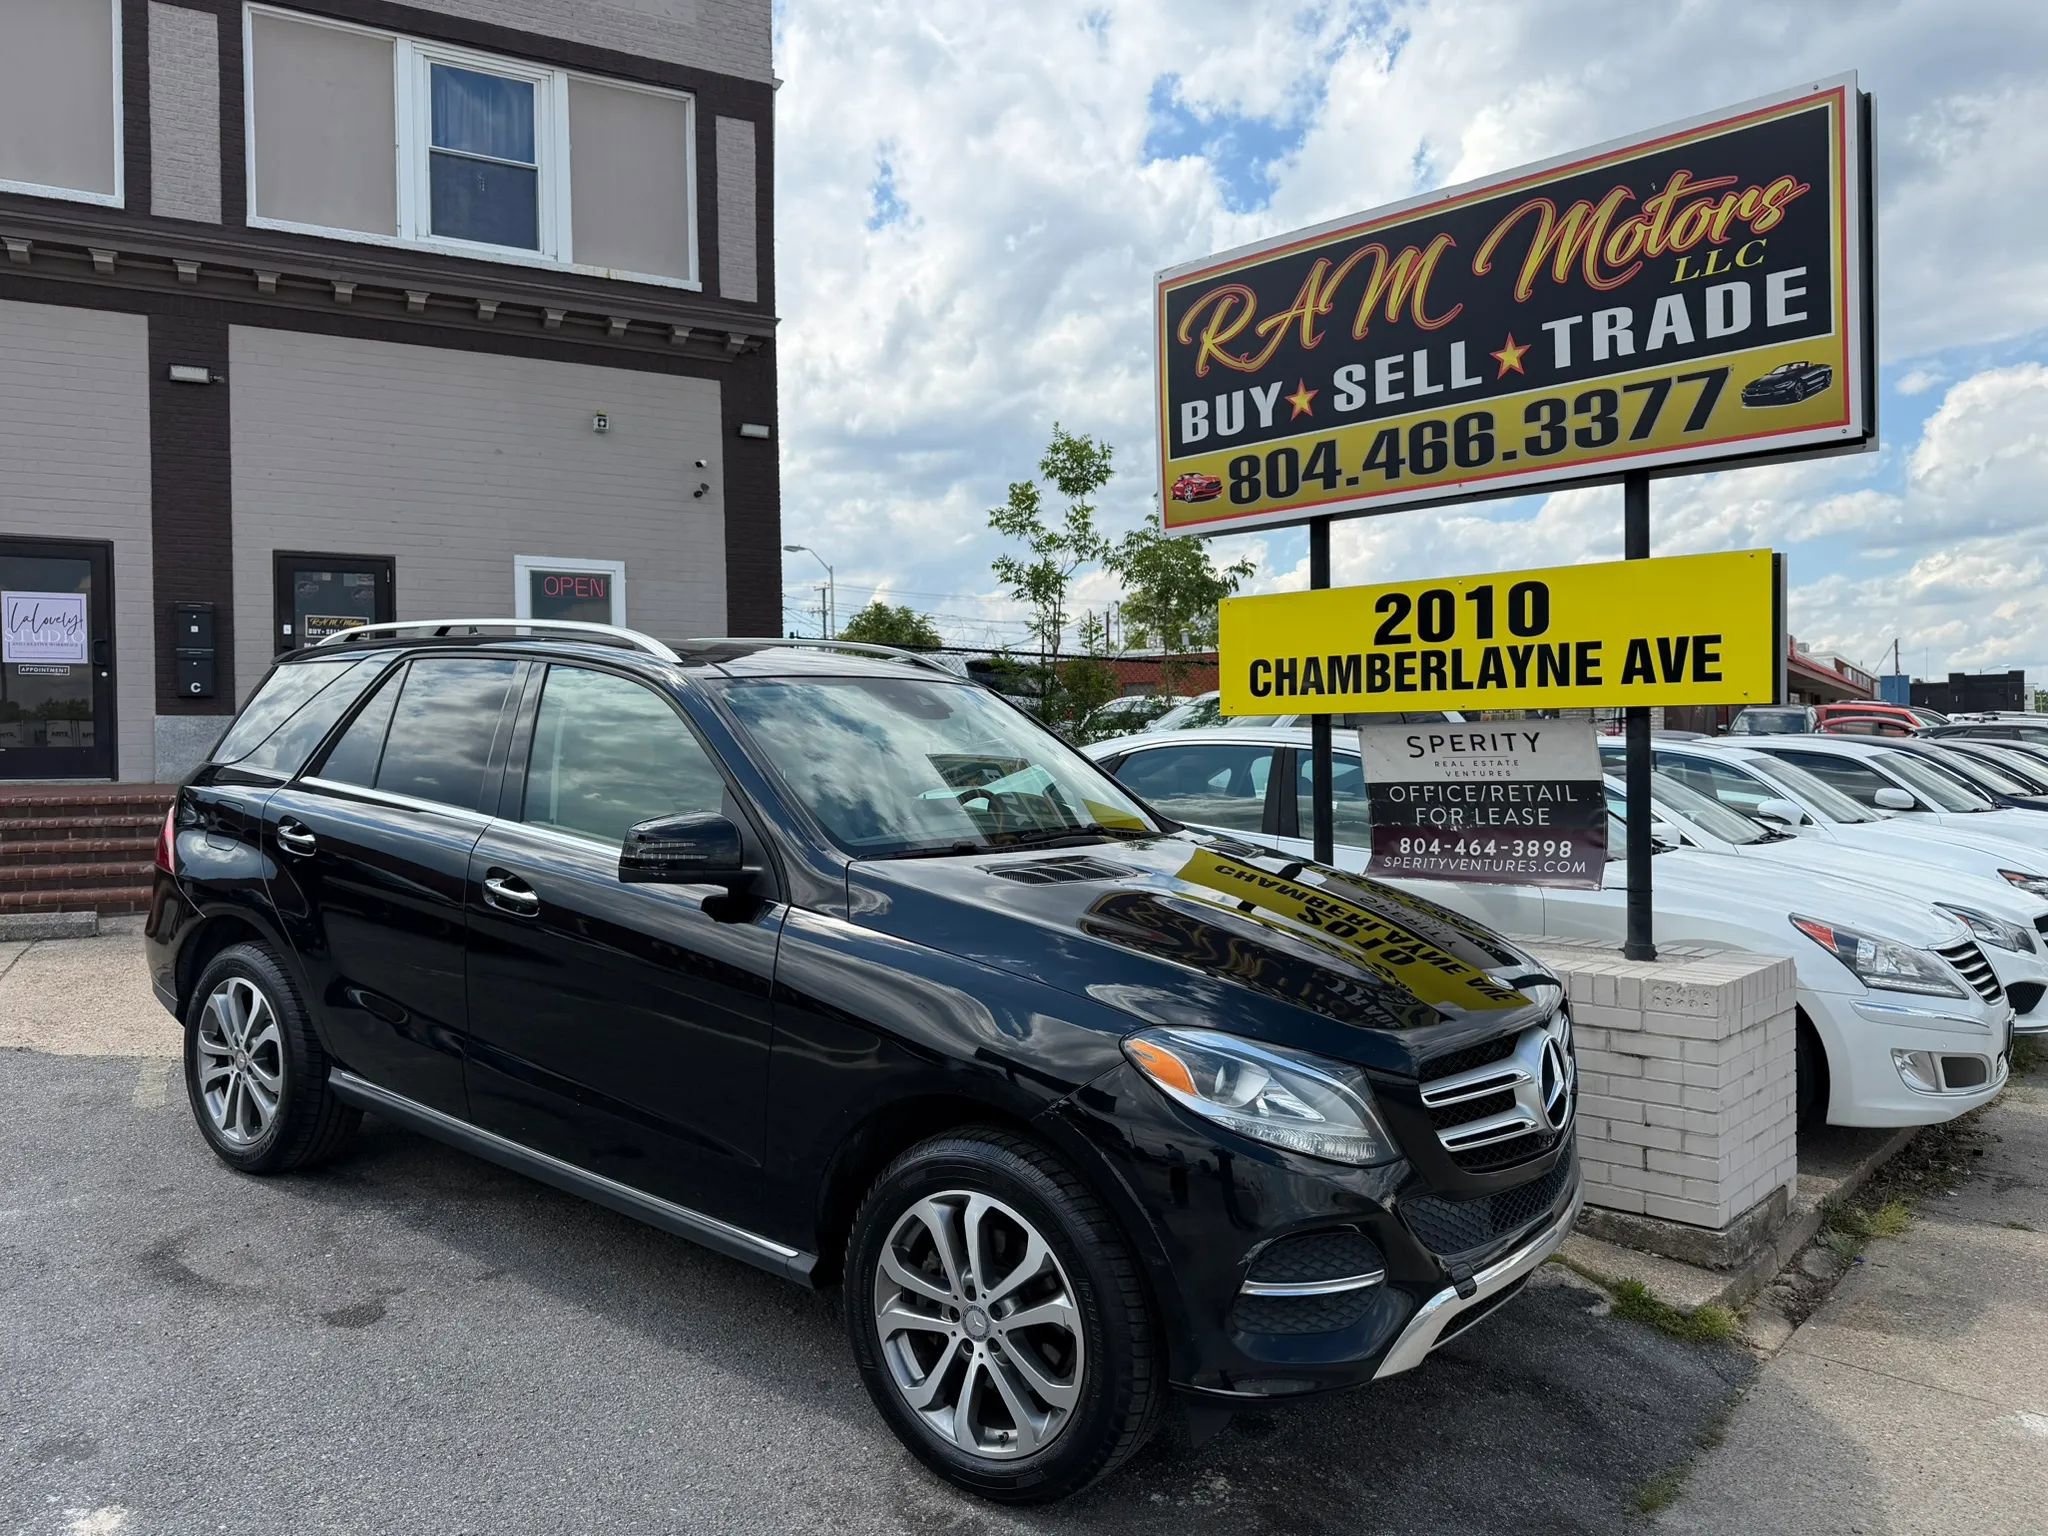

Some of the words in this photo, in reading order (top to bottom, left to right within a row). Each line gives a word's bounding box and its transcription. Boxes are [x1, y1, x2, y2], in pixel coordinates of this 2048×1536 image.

[1670, 238, 1767, 284] LLC
[1178, 234, 1462, 377] RAM
[1473, 169, 1810, 302] Motors
[1180, 381, 1284, 444] BUY
[1333, 340, 1482, 414] SELL
[1542, 266, 1808, 368] TRADE
[1229, 365, 1732, 506] 804.466.3377
[543, 576, 605, 597] OPEN
[1374, 581, 1550, 646] 2010
[4, 629, 85, 643] STUDIO
[1249, 639, 1603, 697] CHAMBERLAYNE
[1621, 634, 1723, 685] AVE
[190, 682, 201, 693] C
[1406, 732, 1540, 758] SPERITY
[1434, 760, 1465, 768] REAL
[1473, 759, 1520, 768] ESTATE
[1389, 785, 1578, 803] OFFICE/RETAIL
[1415, 807, 1464, 826] FOR
[1474, 807, 1551, 826] LEASE
[1399, 838, 1572, 858] 804-464-3898
[1384, 857, 1587, 873] SPERITYVENTURES.COM
